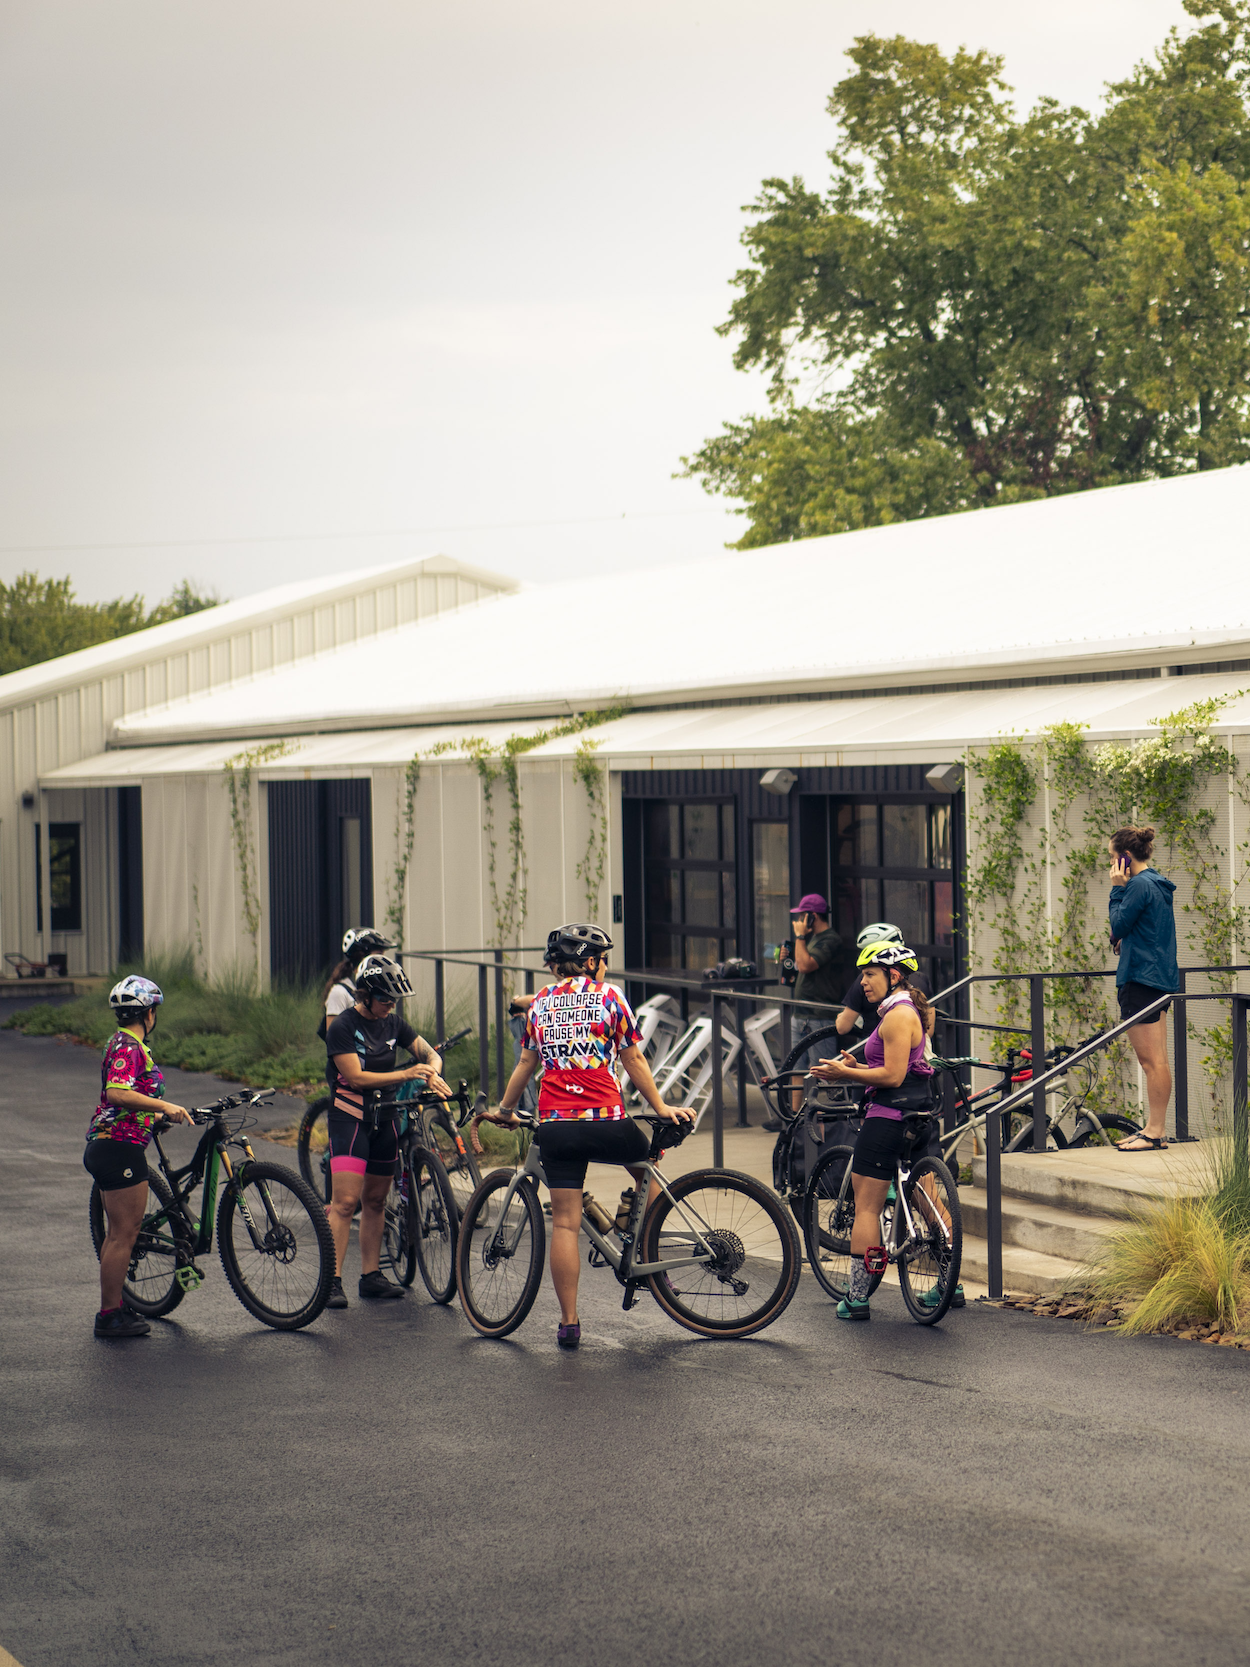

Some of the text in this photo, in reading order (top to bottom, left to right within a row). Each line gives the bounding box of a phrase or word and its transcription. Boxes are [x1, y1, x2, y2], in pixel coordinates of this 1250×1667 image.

[539, 998, 547, 1010] IF
[553, 994, 602, 1008] COLLAPSE
[538, 1010, 601, 1026] CAN SOMEONE
[544, 1026, 590, 1041] PAUSE MY
[541, 1043, 600, 1059] STRAVA
